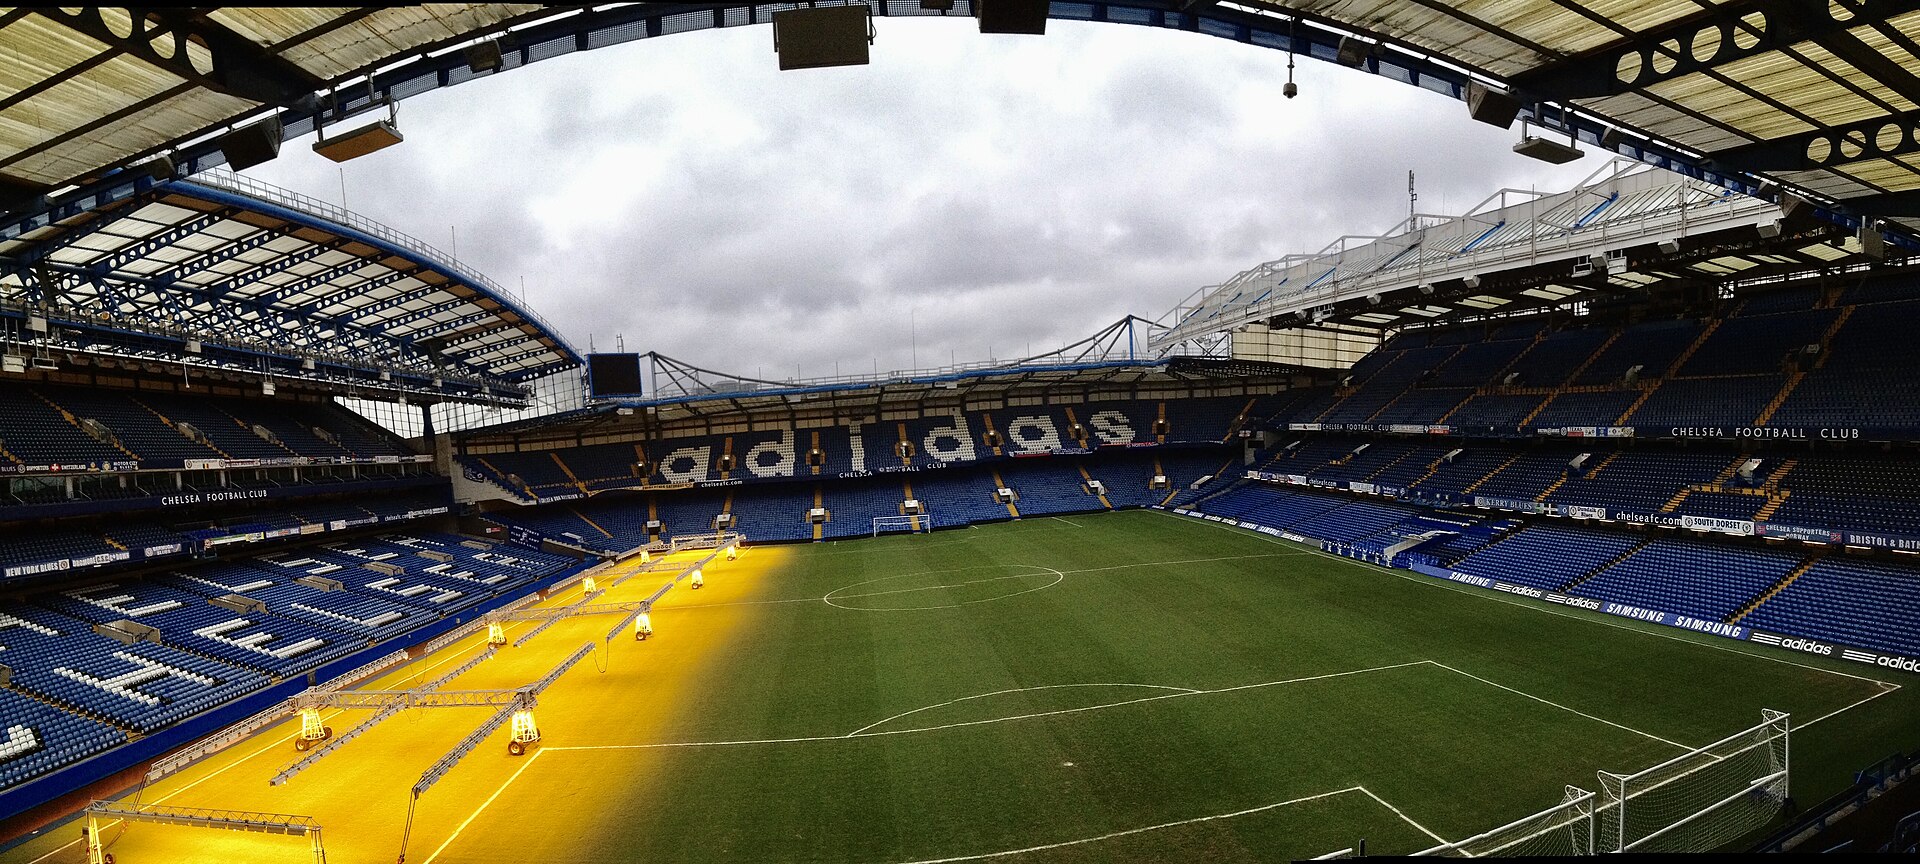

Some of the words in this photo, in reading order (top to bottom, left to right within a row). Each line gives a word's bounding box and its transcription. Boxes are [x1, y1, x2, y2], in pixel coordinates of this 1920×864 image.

[1346, 423, 1374, 431] FOOTBALL
[1671, 427, 1723, 437] CHELSEA
[1735, 427, 1806, 438] FOOTBALL
[1820, 428, 1859, 438] CLUB
[660, 406, 1136, 484] adidas
[700, 479, 743, 488] chelseafc.com
[161, 494, 201, 506] CHELSEA
[206, 491, 247, 502] FOOTBALL
[248, 489, 268, 498] CLUB
[1485, 499, 1508, 507] KERRY
[1510, 500, 1532, 510] BLUES
[1616, 511, 1682, 526] chelseafc.com
[1693, 517, 1714, 527] SOUTH
[1715, 519, 1741, 529] DORSET
[1765, 524, 1791, 533] CHELSEA
[1792, 526, 1830, 537] SUPPORTERS
[1785, 532, 1810, 541] NORWAY
[1850, 534, 1887, 547] BRISTOL
[1889, 539, 1896, 547] &
[116, 551, 130, 560] DOWN
[5, 567, 21, 577] NEW
[21, 565, 40, 575] YORK
[40, 563, 59, 573] BLUES
[1449, 571, 1490, 587] SAMSUNG
[1511, 584, 1542, 598] adidas
[1565, 595, 1600, 610] adidas
[1606, 602, 1665, 623] SAMSUNG
[1674, 615, 1742, 638] SAMSUNG
[1781, 637, 1833, 656] adidas
